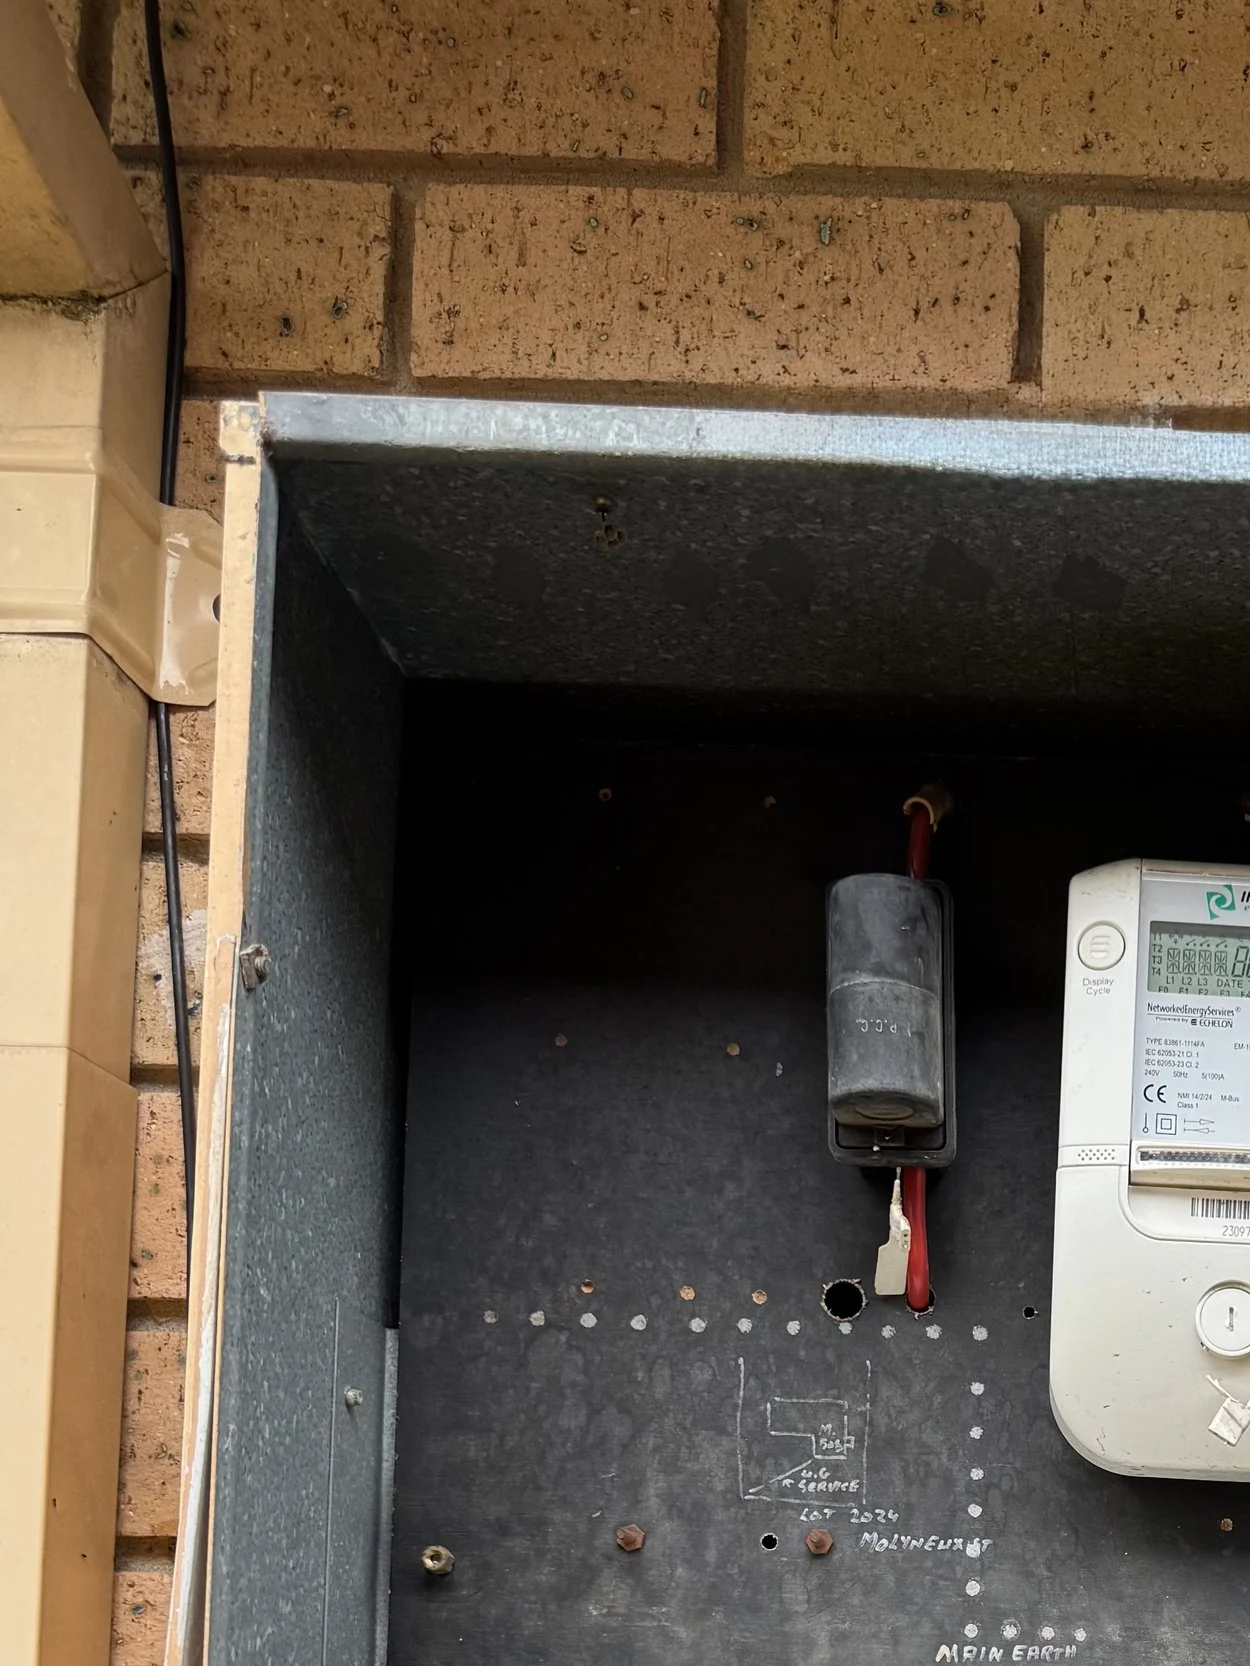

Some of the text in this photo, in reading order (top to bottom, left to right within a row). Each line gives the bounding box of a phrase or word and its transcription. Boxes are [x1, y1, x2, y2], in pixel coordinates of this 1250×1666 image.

[1152, 944, 1162, 953] T2
[1152, 955, 1162, 964] T3
[1151, 966, 1161, 976] T4
[1082, 977, 1114, 986] Display
[1166, 976, 1175, 985] L1
[1182, 976, 1192, 986] L2
[1197, 978, 1208, 986] L3
[1216, 979, 1243, 989] DATE
[1086, 987, 1110, 996] Cycle
[1199, 1019, 1233, 1028] ECHELON
[1146, 1038, 1162, 1046] TYPE
[1146, 1048, 1156, 1056] IEC
[1173, 1070, 1188, 1078] 50Hz
[800, 1508, 899, 1524] LOT 2024
[854, 1532, 964, 1552] MOLYNEUX
[935, 1644, 1077, 1664] MAIN EARTH
